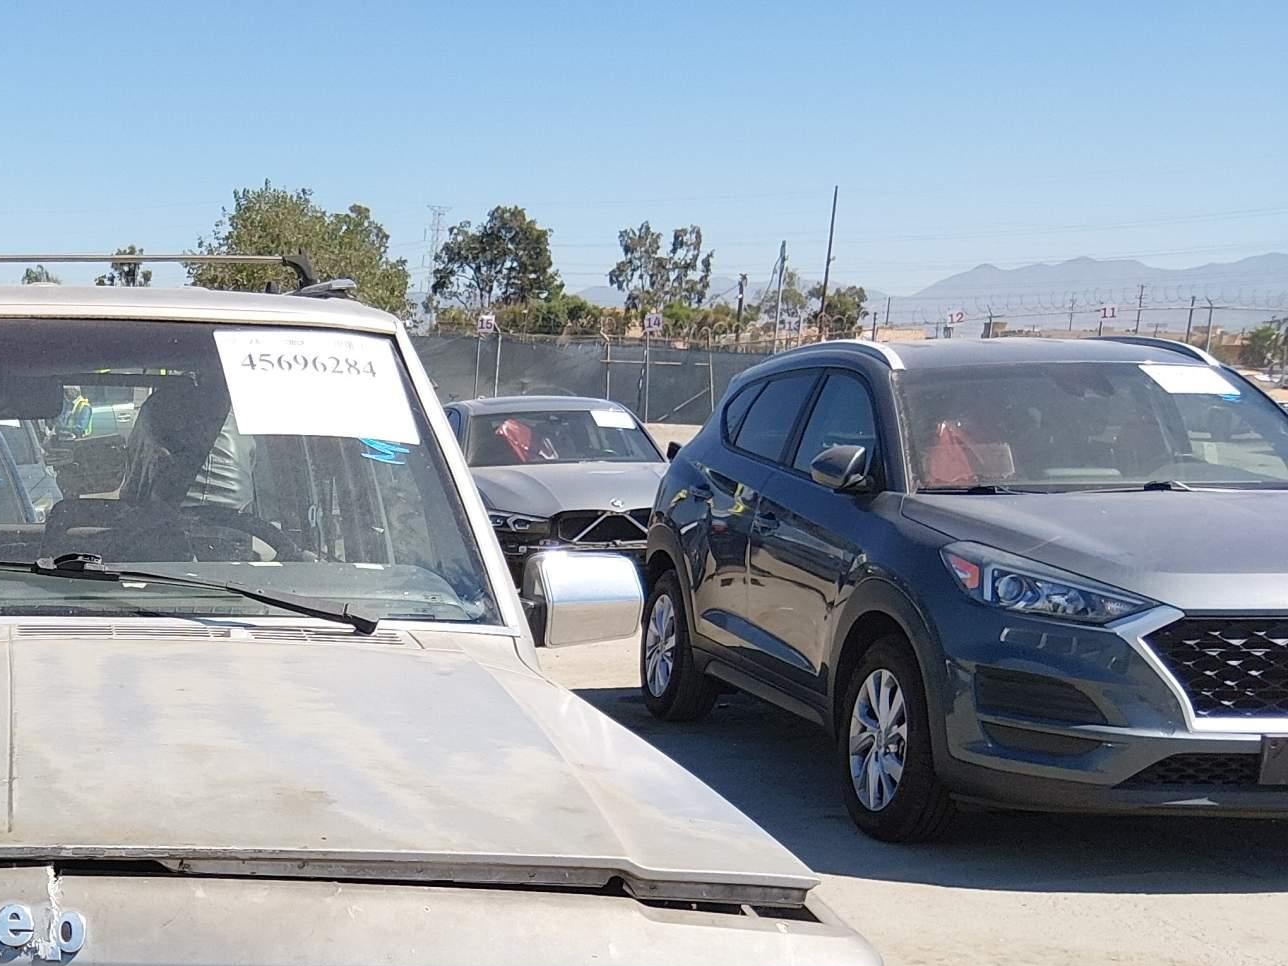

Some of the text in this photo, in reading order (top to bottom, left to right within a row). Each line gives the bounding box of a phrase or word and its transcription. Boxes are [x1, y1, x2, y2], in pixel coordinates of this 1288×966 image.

[948, 311, 964, 324] 12
[1101, 307, 1117, 319] 11
[478, 318, 493, 330] 15
[647, 317, 661, 329] 14
[240, 353, 377, 377] 45696284
